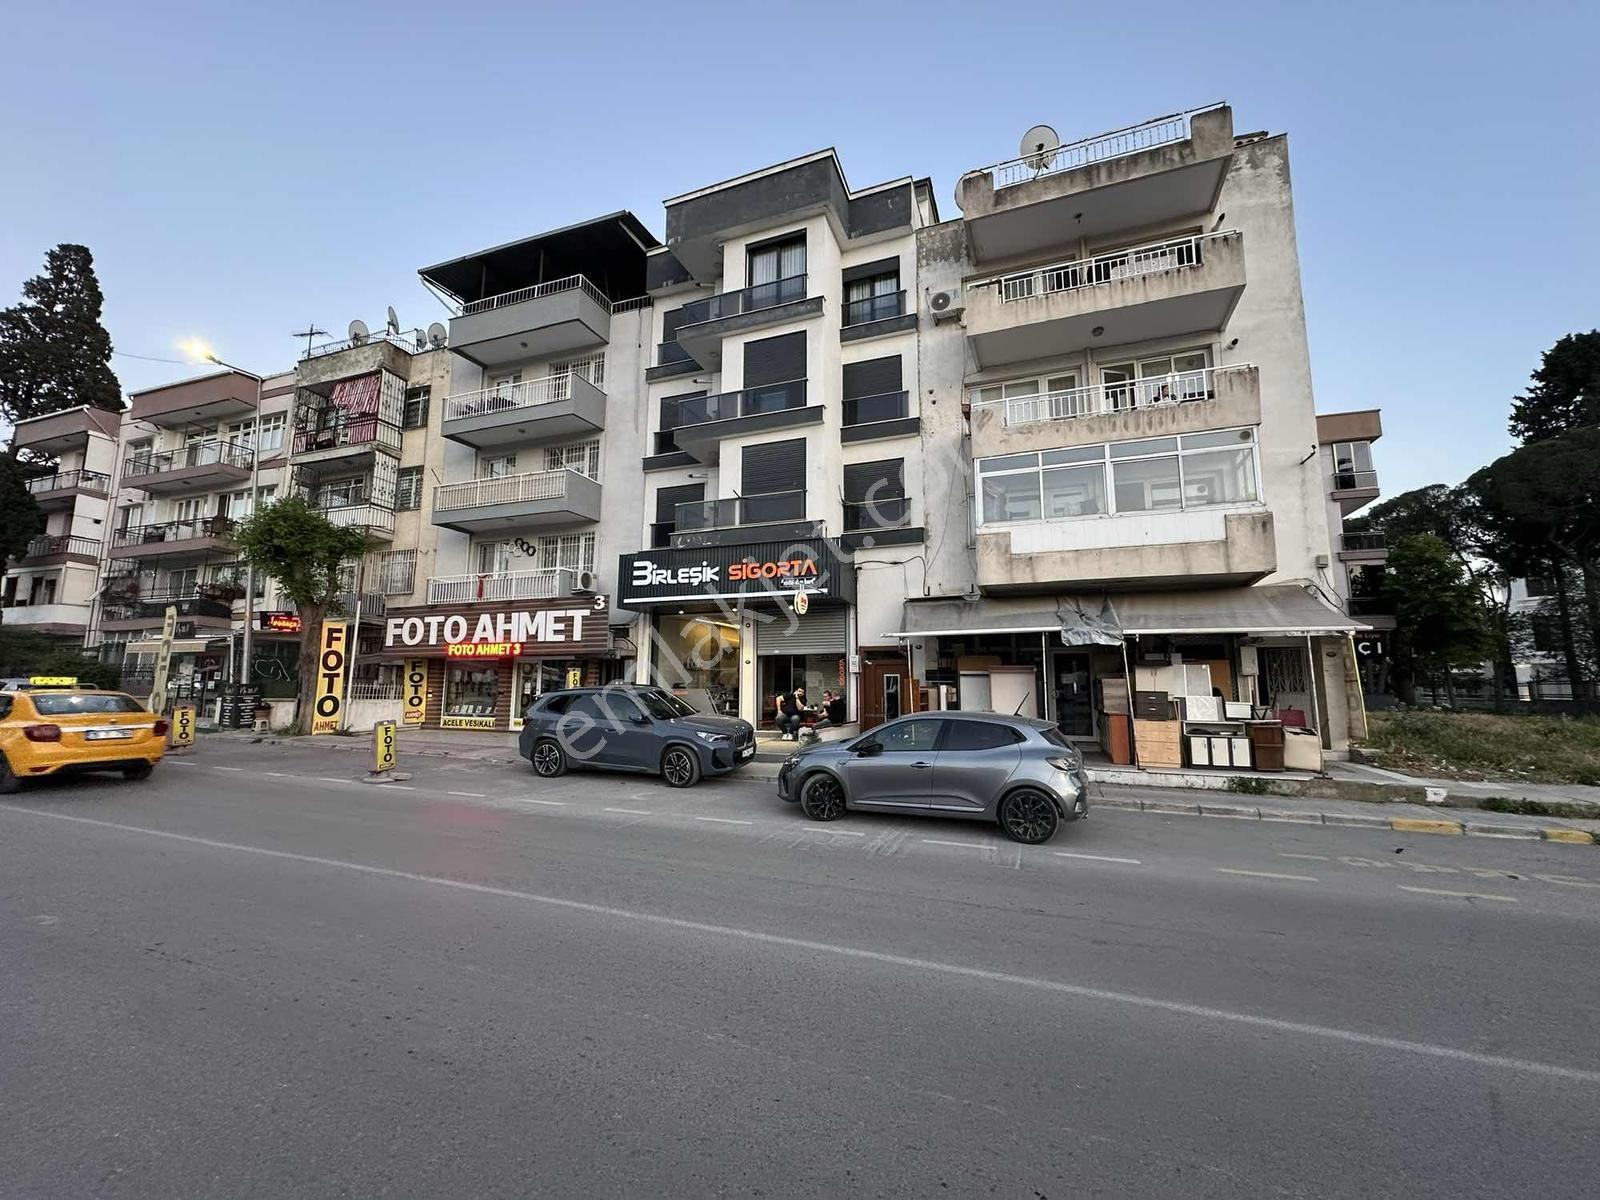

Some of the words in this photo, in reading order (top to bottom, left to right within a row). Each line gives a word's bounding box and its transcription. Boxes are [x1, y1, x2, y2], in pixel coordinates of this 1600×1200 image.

[728, 557, 818, 582] SİGORTA
[593, 595, 606, 610] 3
[386, 615, 468, 647] FOTO
[471, 609, 591, 644] AHMET
[447, 644, 475, 656] FOTO
[476, 643, 512, 655] AHMET
[513, 643, 521, 654] 3
[316, 627, 343, 717] FOTO
[408, 661, 424, 707] FOTO
[179, 711, 189, 740] FOTO
[313, 720, 338, 732] AHMET
[442, 719, 464, 727] ACELE
[383, 726, 393, 763] FOTO
